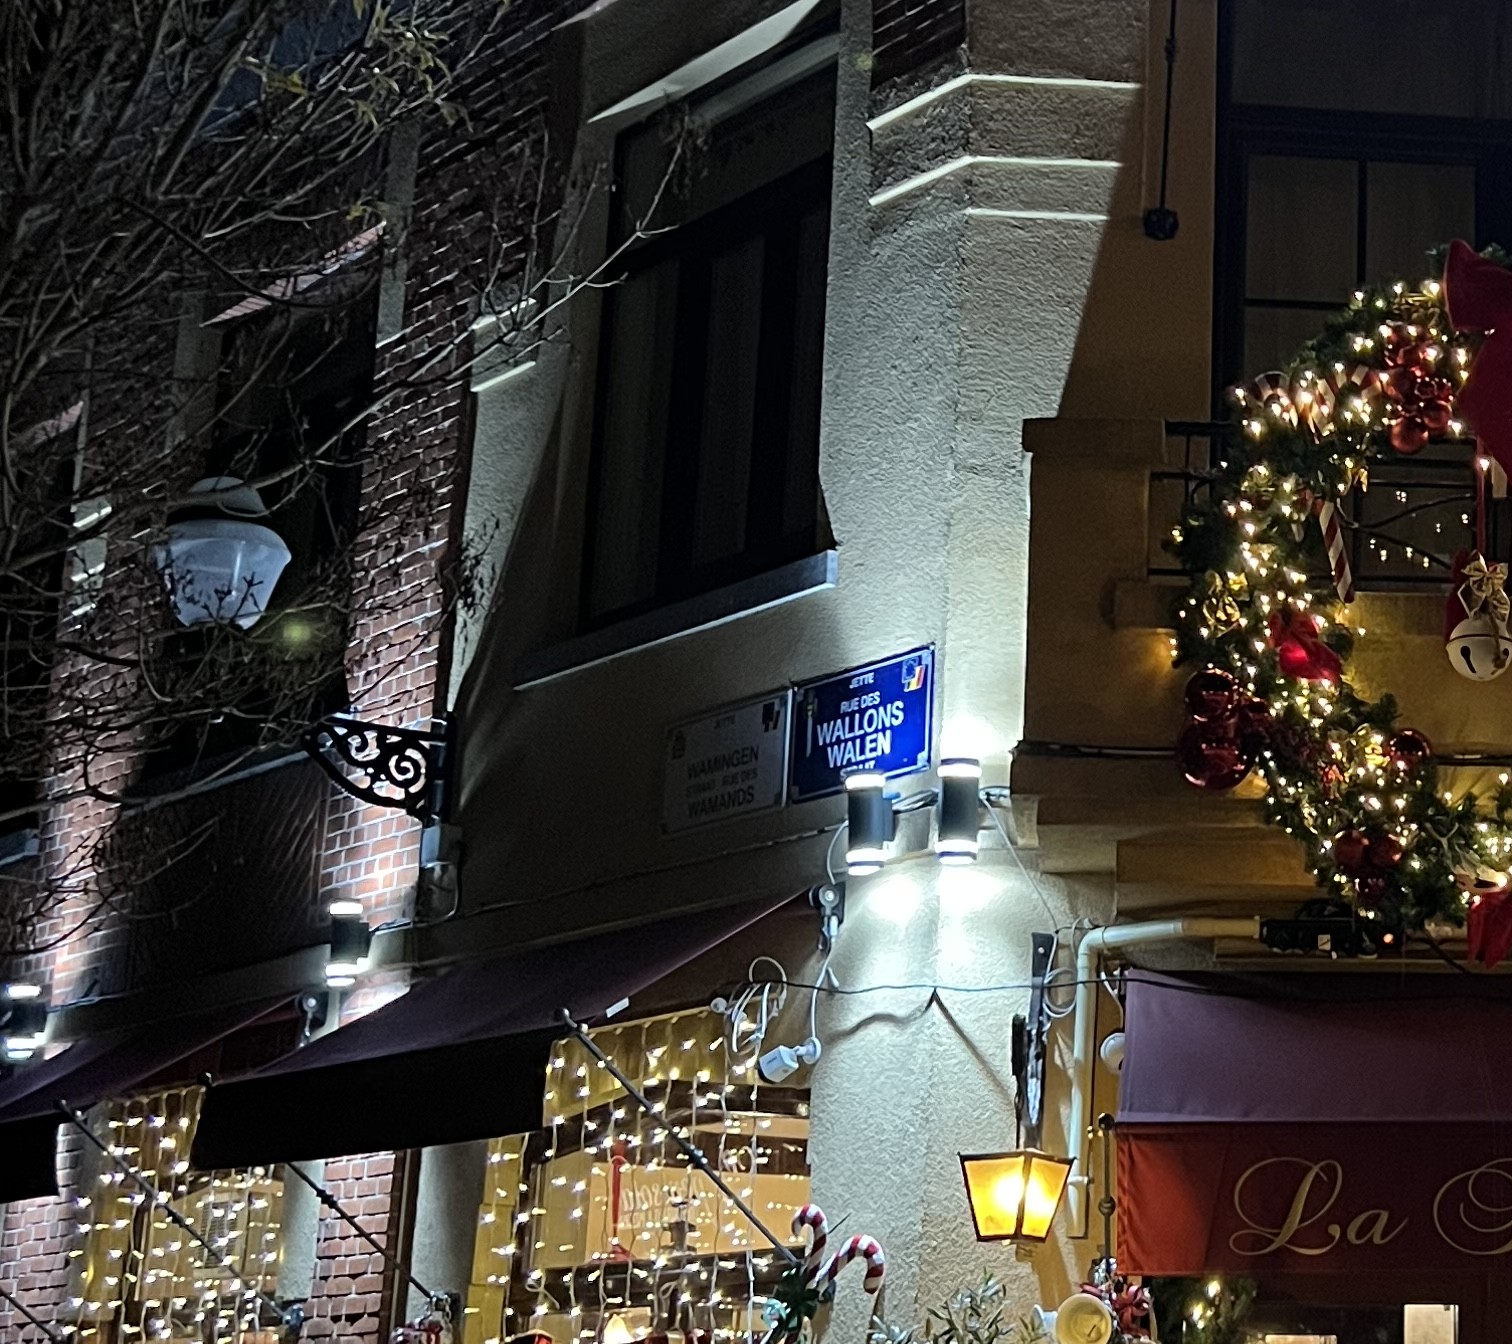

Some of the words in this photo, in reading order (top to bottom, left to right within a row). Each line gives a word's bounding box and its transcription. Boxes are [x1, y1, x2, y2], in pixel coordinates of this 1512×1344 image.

[849, 672, 875, 689] JETTE
[840, 697, 860, 714] RUE
[861, 691, 881, 709] DES
[816, 700, 905, 747] WALLONS
[827, 729, 892, 769] WALEN
[1229, 1156, 1409, 1256] La
